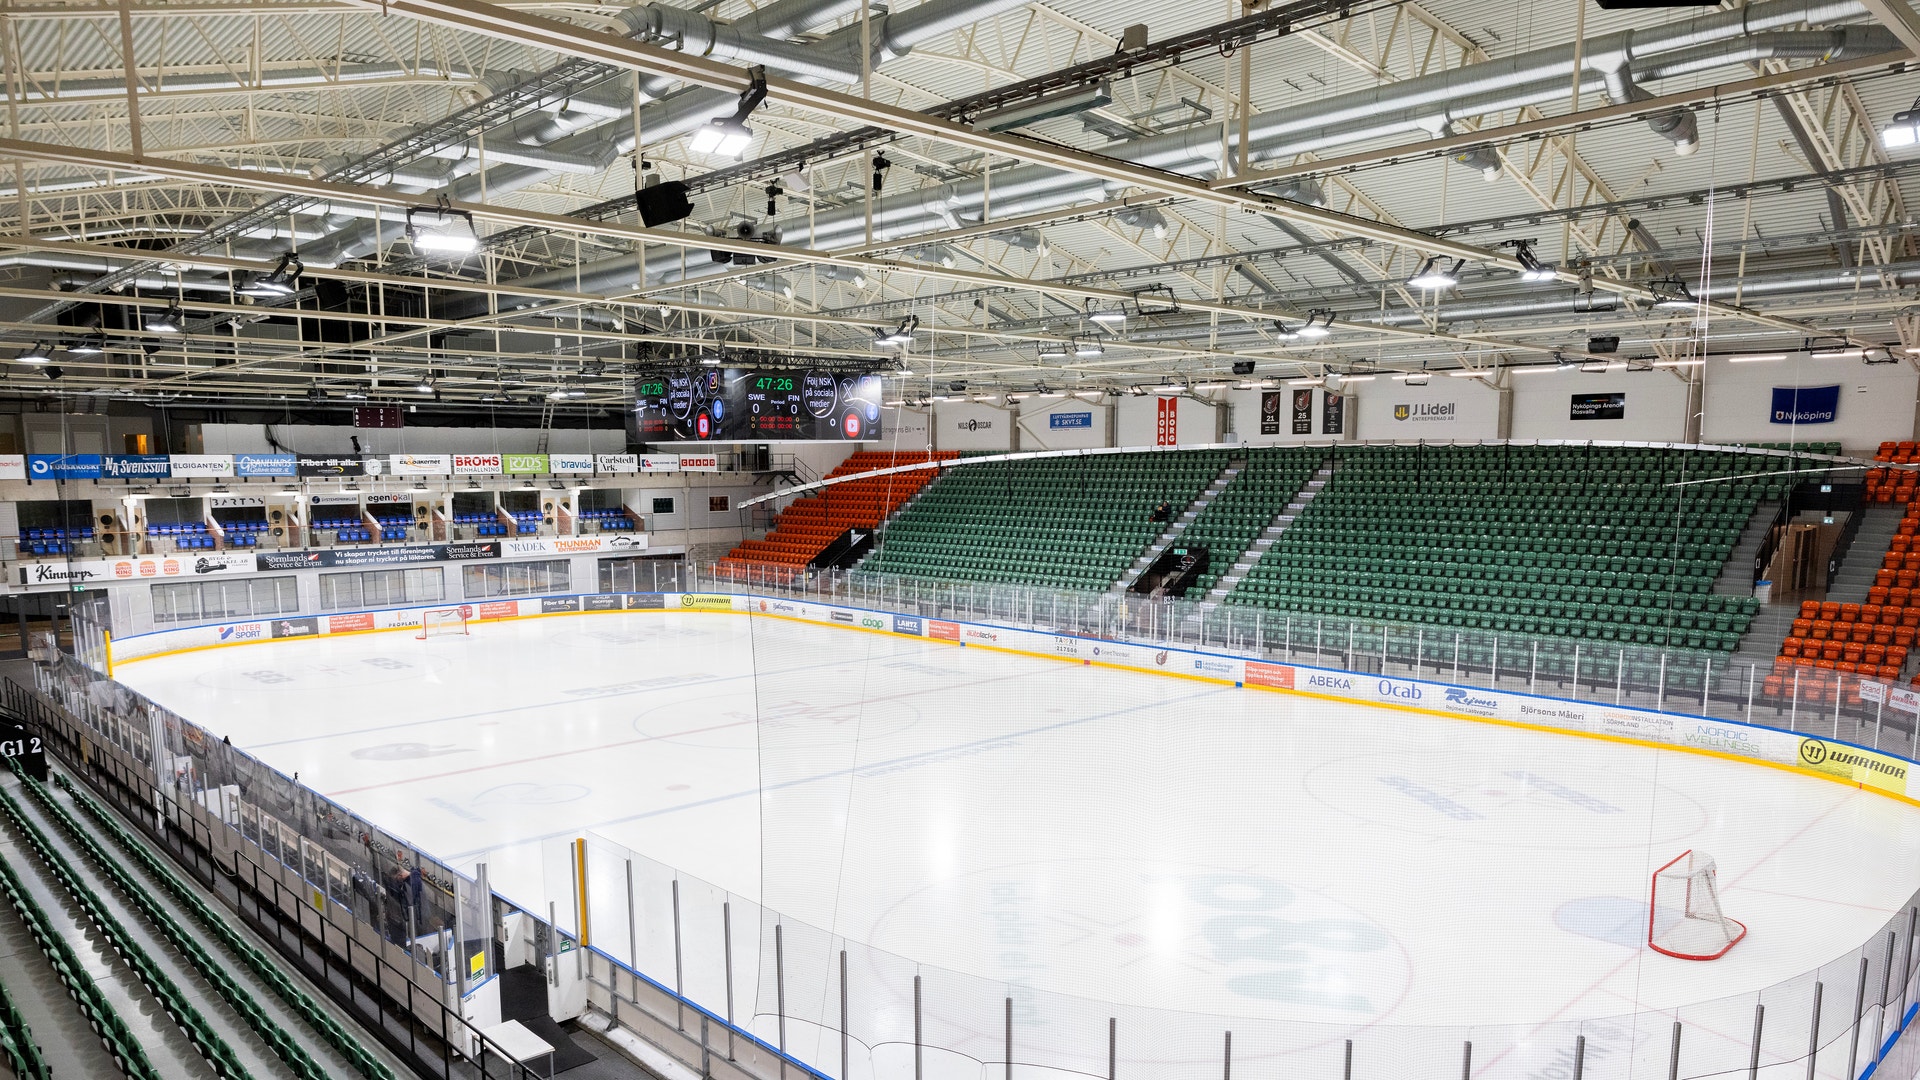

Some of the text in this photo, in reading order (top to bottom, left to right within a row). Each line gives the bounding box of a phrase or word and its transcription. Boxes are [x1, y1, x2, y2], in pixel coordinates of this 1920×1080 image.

[756, 378, 793, 391] 47:26
[819, 377, 832, 386] NSK
[641, 383, 663, 395] 47:26
[814, 389, 834, 398] sociala
[748, 393, 766, 401] SWE
[752, 403, 760, 414] 0
[809, 399, 830, 408] medier
[1572, 402, 1602, 411] Nyköpings
[791, 404, 798, 414] 0
[1412, 402, 1455, 416] J Lidell
[1785, 410, 1832, 422] Nyköping
[958, 421, 992, 430] NILS OSCAR
[301, 459, 359, 467] Fiber till alla.
[456, 456, 500, 467] BROMS
[509, 456, 542, 468] RYDS
[561, 459, 592, 469] bravida
[600, 455, 635, 464] Carlstedt
[120, 459, 168, 474] Svensson
[173, 462, 224, 470] ELGIGANTEN
[601, 463, 618, 472] Ark.
[554, 539, 601, 548] THUNMAN
[344, 551, 366, 559] skapar
[400, 547, 435, 555] föreningen,
[446, 545, 482, 554] Sörmlands
[477, 550, 494, 558] Event
[266, 554, 307, 563] Sörmlands
[376, 556, 398, 564] trycket
[269, 561, 294, 569] Service
[36, 565, 96, 582] Kinnarps
[235, 623, 261, 632] INTER
[862, 617, 884, 629] coop
[897, 620, 918, 629] LANTZ
[235, 630, 261, 639] SPORT
[1309, 675, 1351, 690] ABEKA
[1378, 679, 1422, 700] Ocab
[1444, 687, 1498, 708] Rejmes
[1520, 704, 1585, 720] Björsons Måleri
[1697, 725, 1748, 742] NORDIC
[0, 737, 42, 757] G1 2
[1685, 732, 1760, 754] WELLNESS
[1829, 750, 1906, 780] WARRIOR
